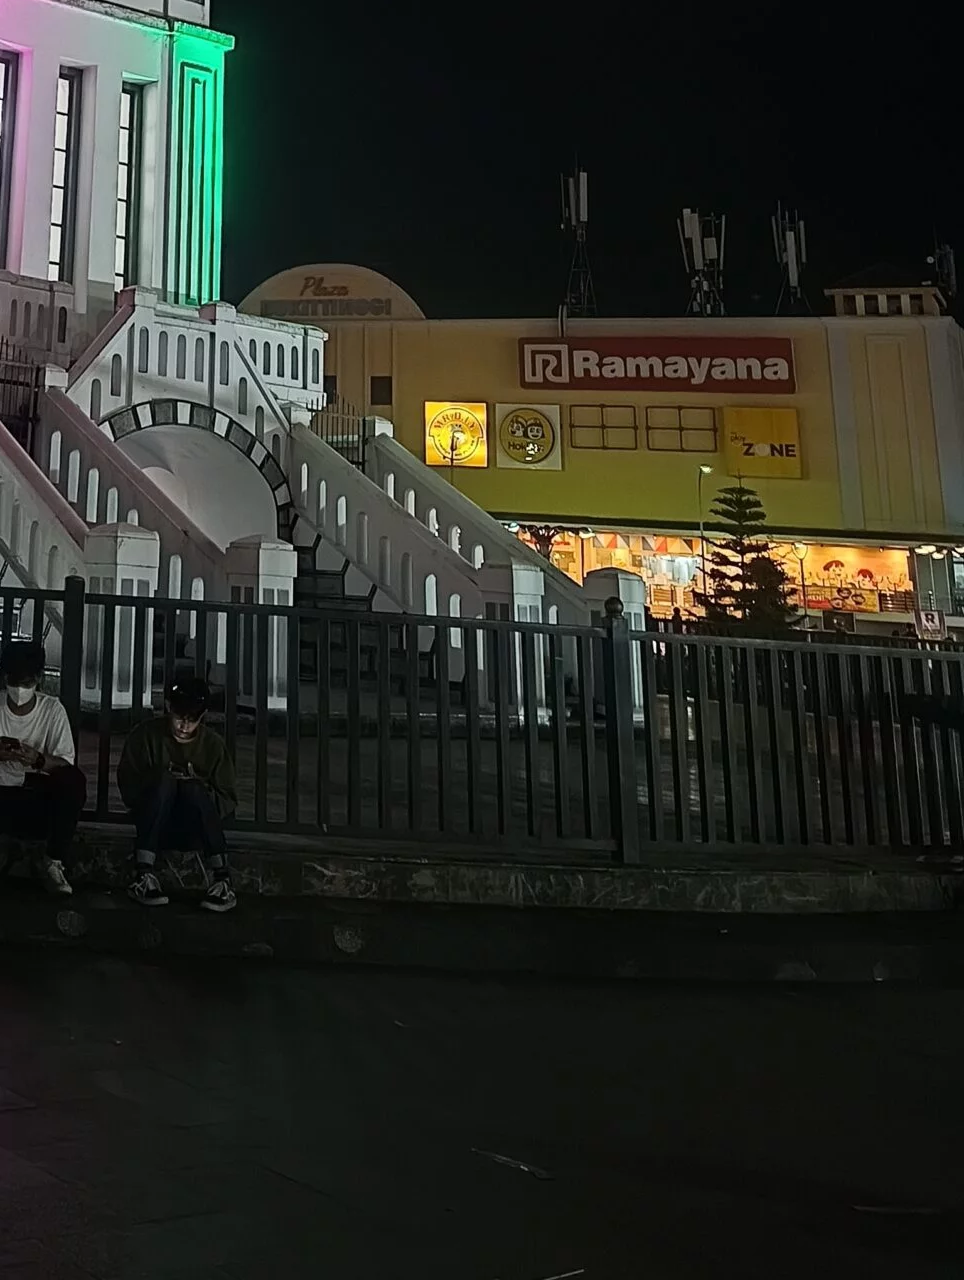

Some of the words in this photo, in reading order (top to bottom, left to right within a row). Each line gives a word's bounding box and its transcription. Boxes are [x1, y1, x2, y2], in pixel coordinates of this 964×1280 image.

[300, 276, 349, 297] Plaza
[573, 350, 789, 385] Ramayana
[743, 442, 796, 458] ZONE
